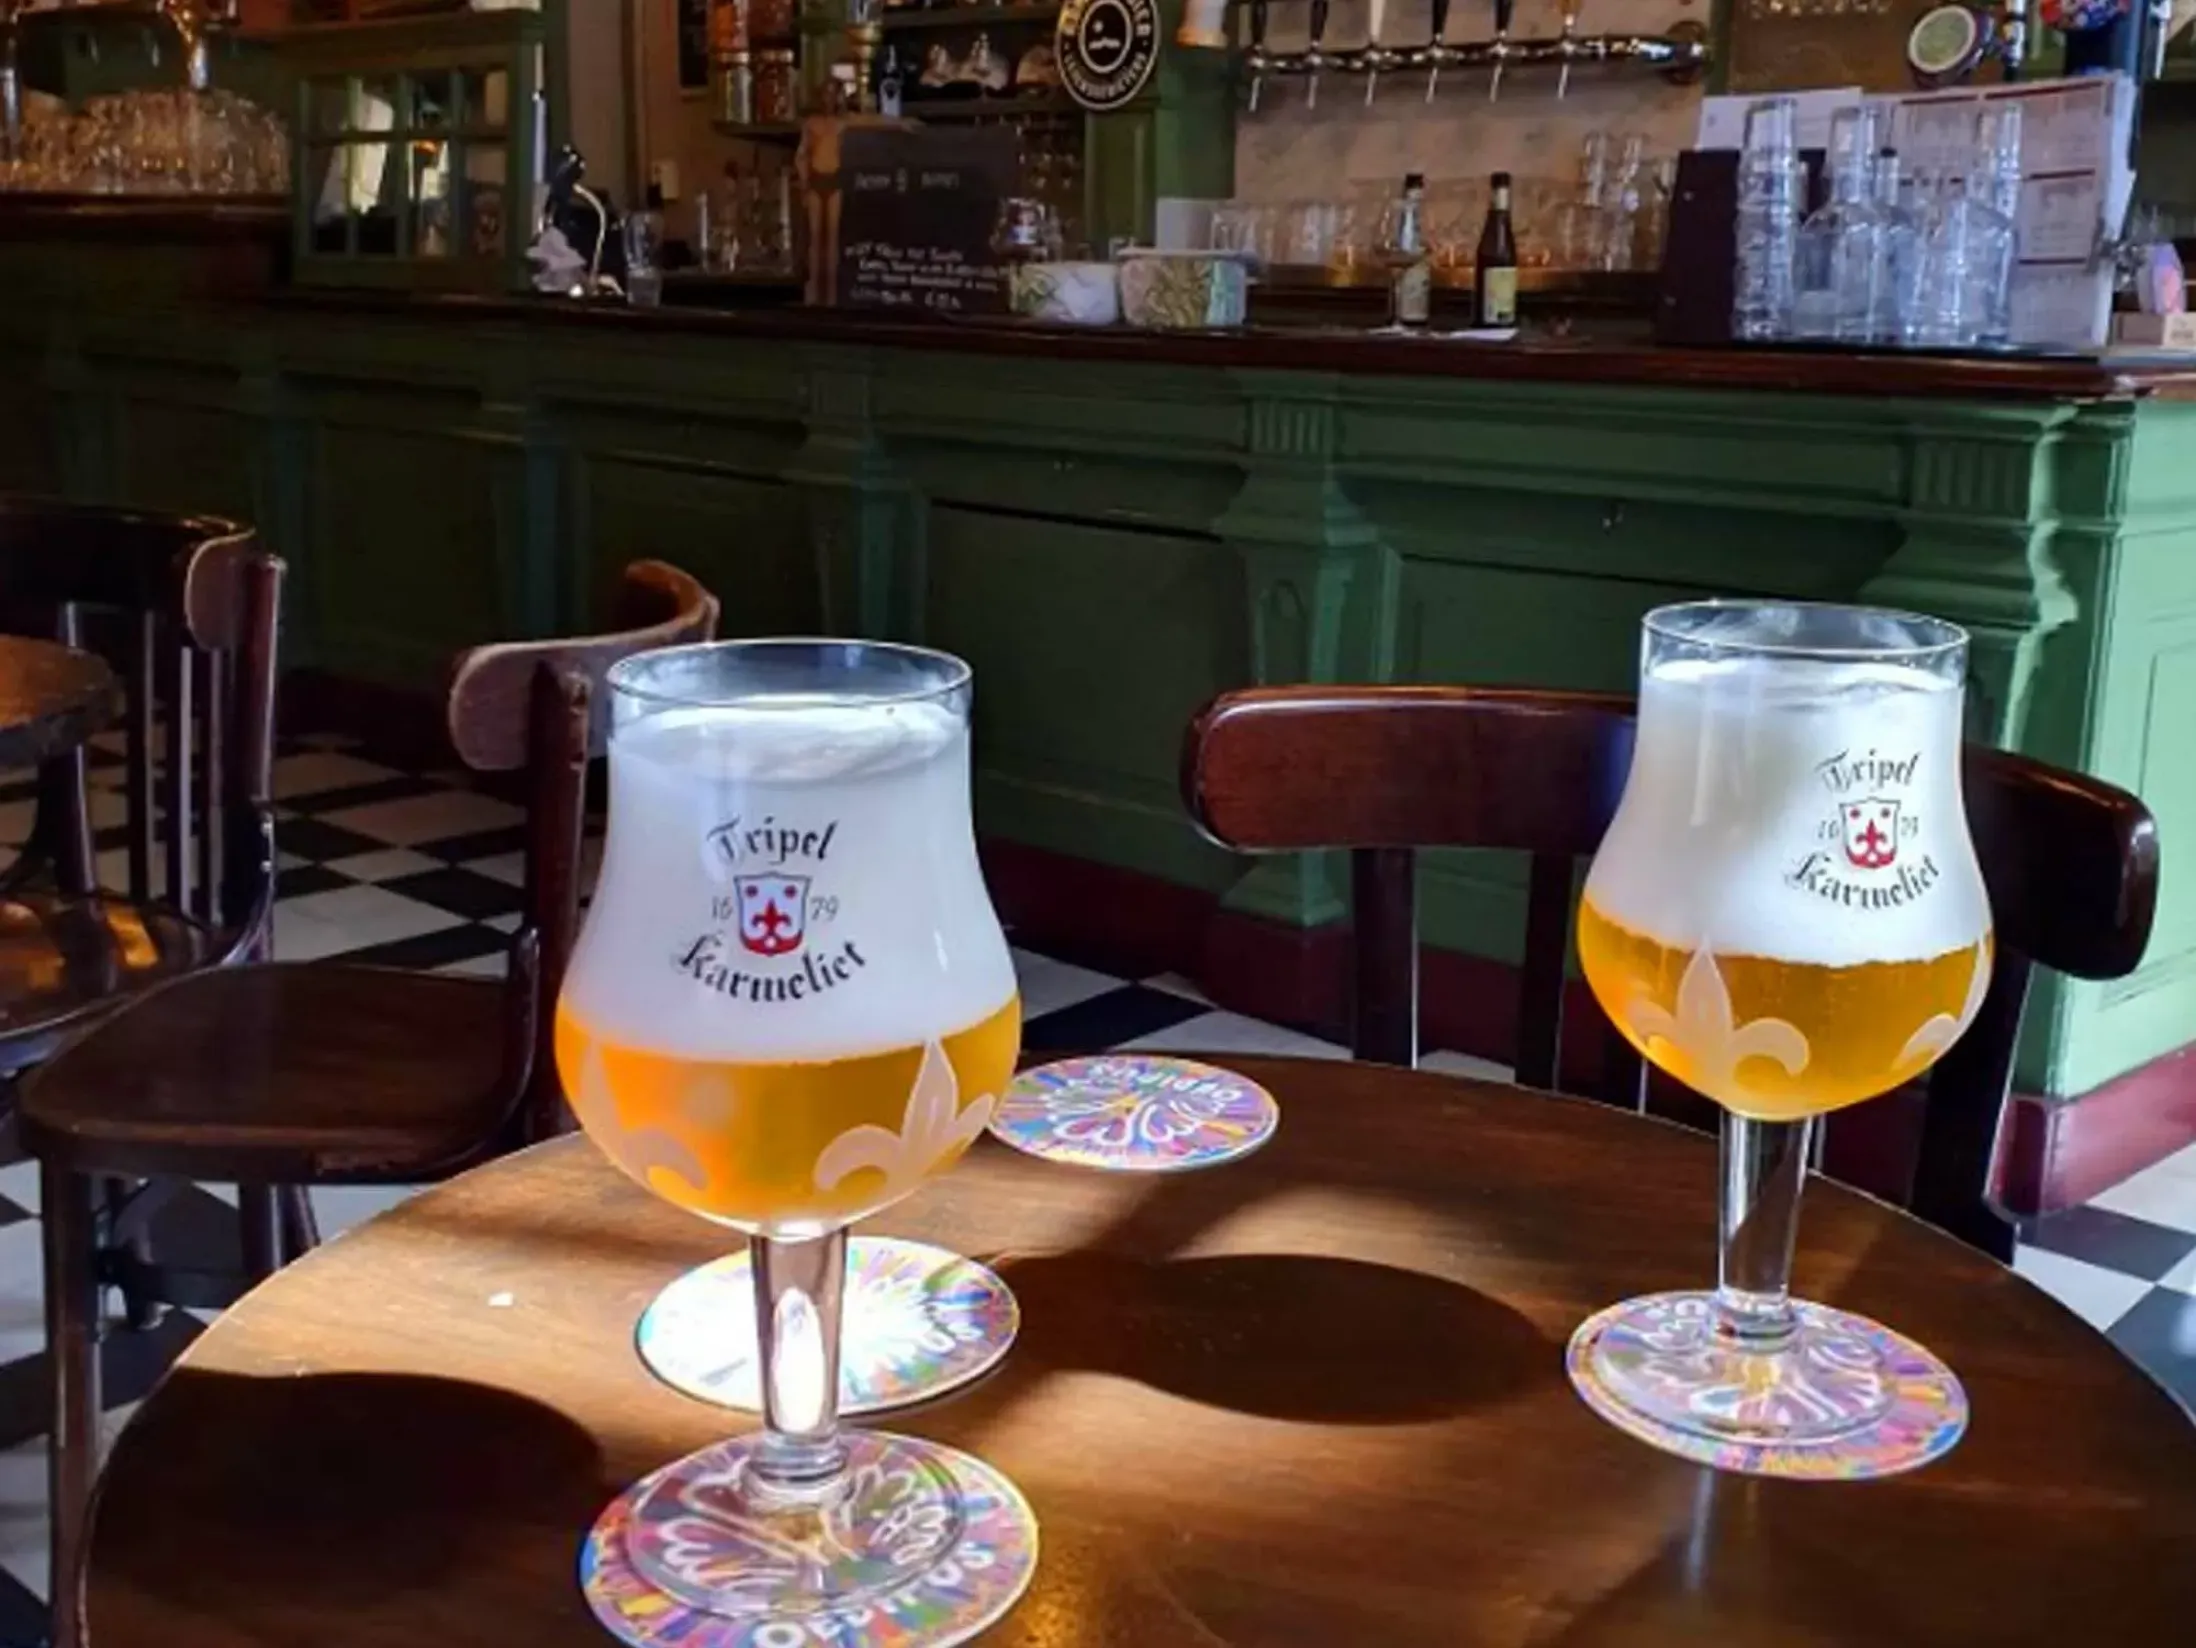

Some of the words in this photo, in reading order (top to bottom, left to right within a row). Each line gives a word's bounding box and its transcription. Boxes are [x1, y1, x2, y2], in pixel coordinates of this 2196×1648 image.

[1814, 748, 1920, 792] Tripel
[707, 815, 838, 865] Tripel
[1785, 850, 1939, 908] Karmeliet
[811, 895, 839, 922] 79
[673, 931, 866, 1002] Karmeliet
